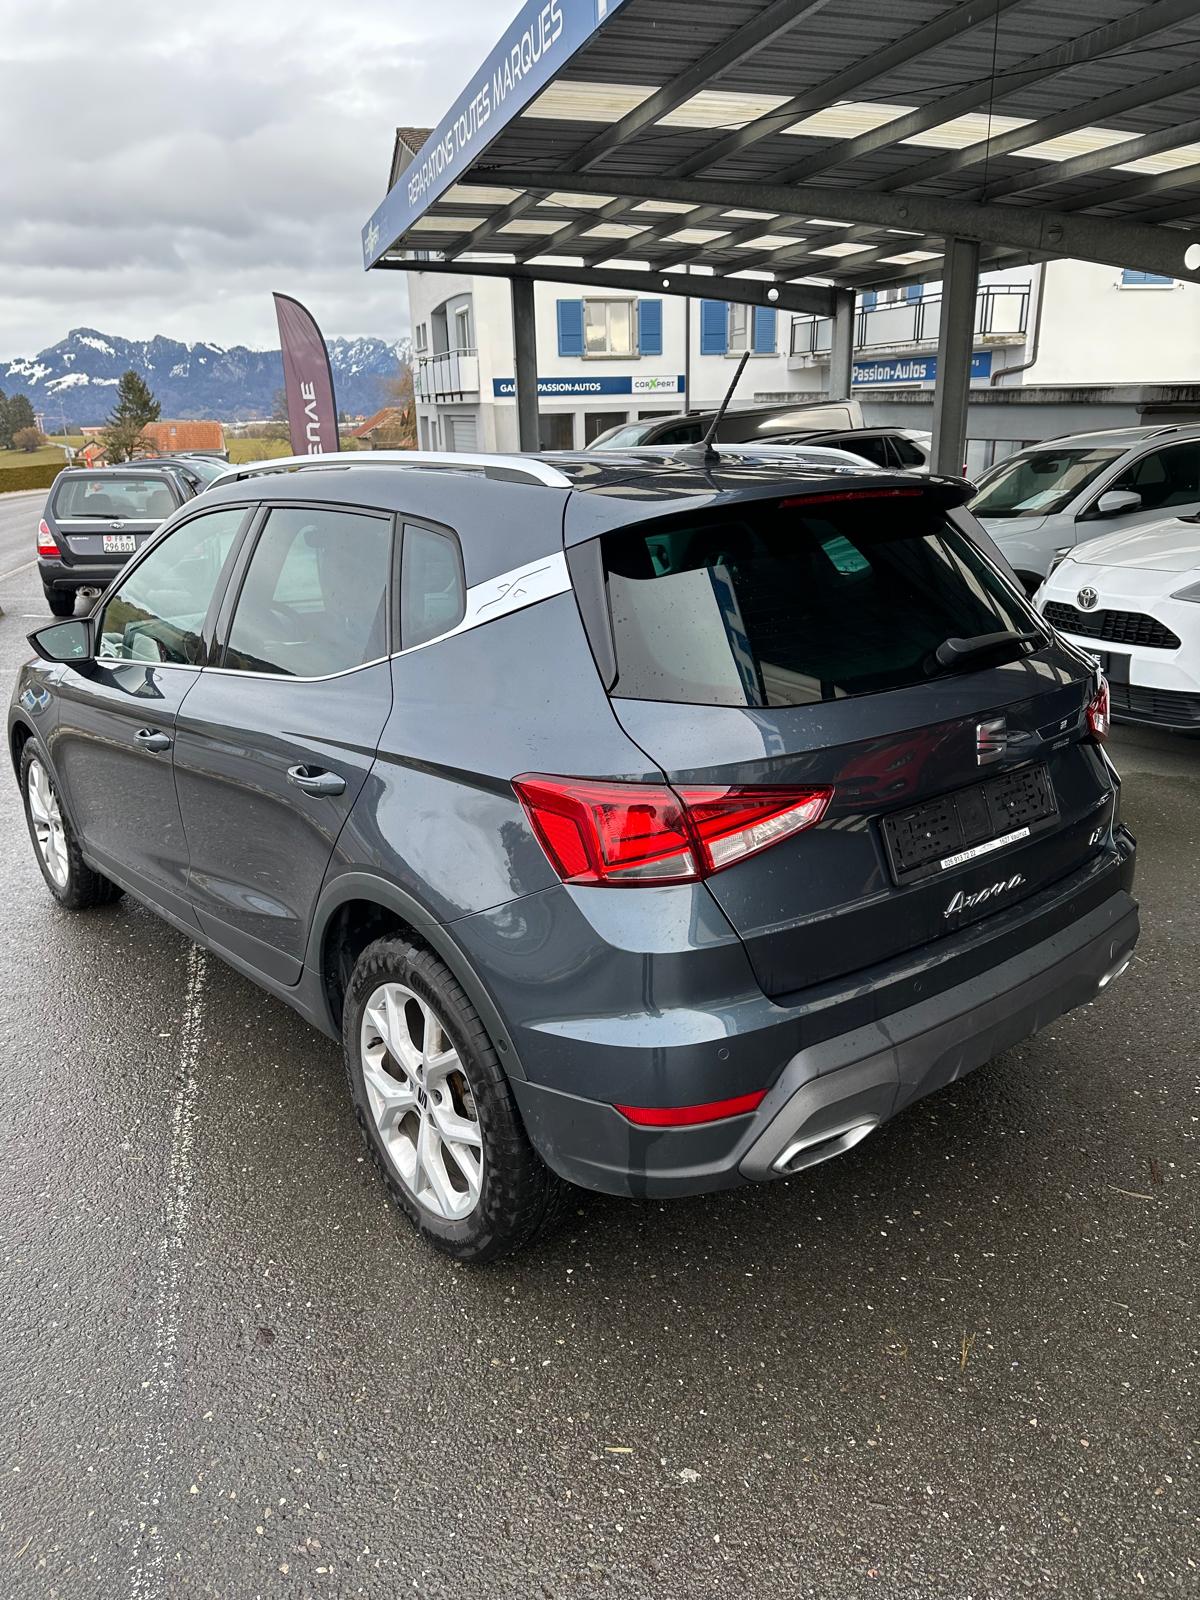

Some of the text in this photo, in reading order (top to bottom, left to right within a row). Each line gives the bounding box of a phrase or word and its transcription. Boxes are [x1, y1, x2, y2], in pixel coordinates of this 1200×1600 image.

[453, 82, 491, 153] TOUTES
[492, 0, 564, 111] MARQUES
[852, 360, 927, 382] Passion-Autos
[537, 382, 601, 392] PASSION-AUTOS
